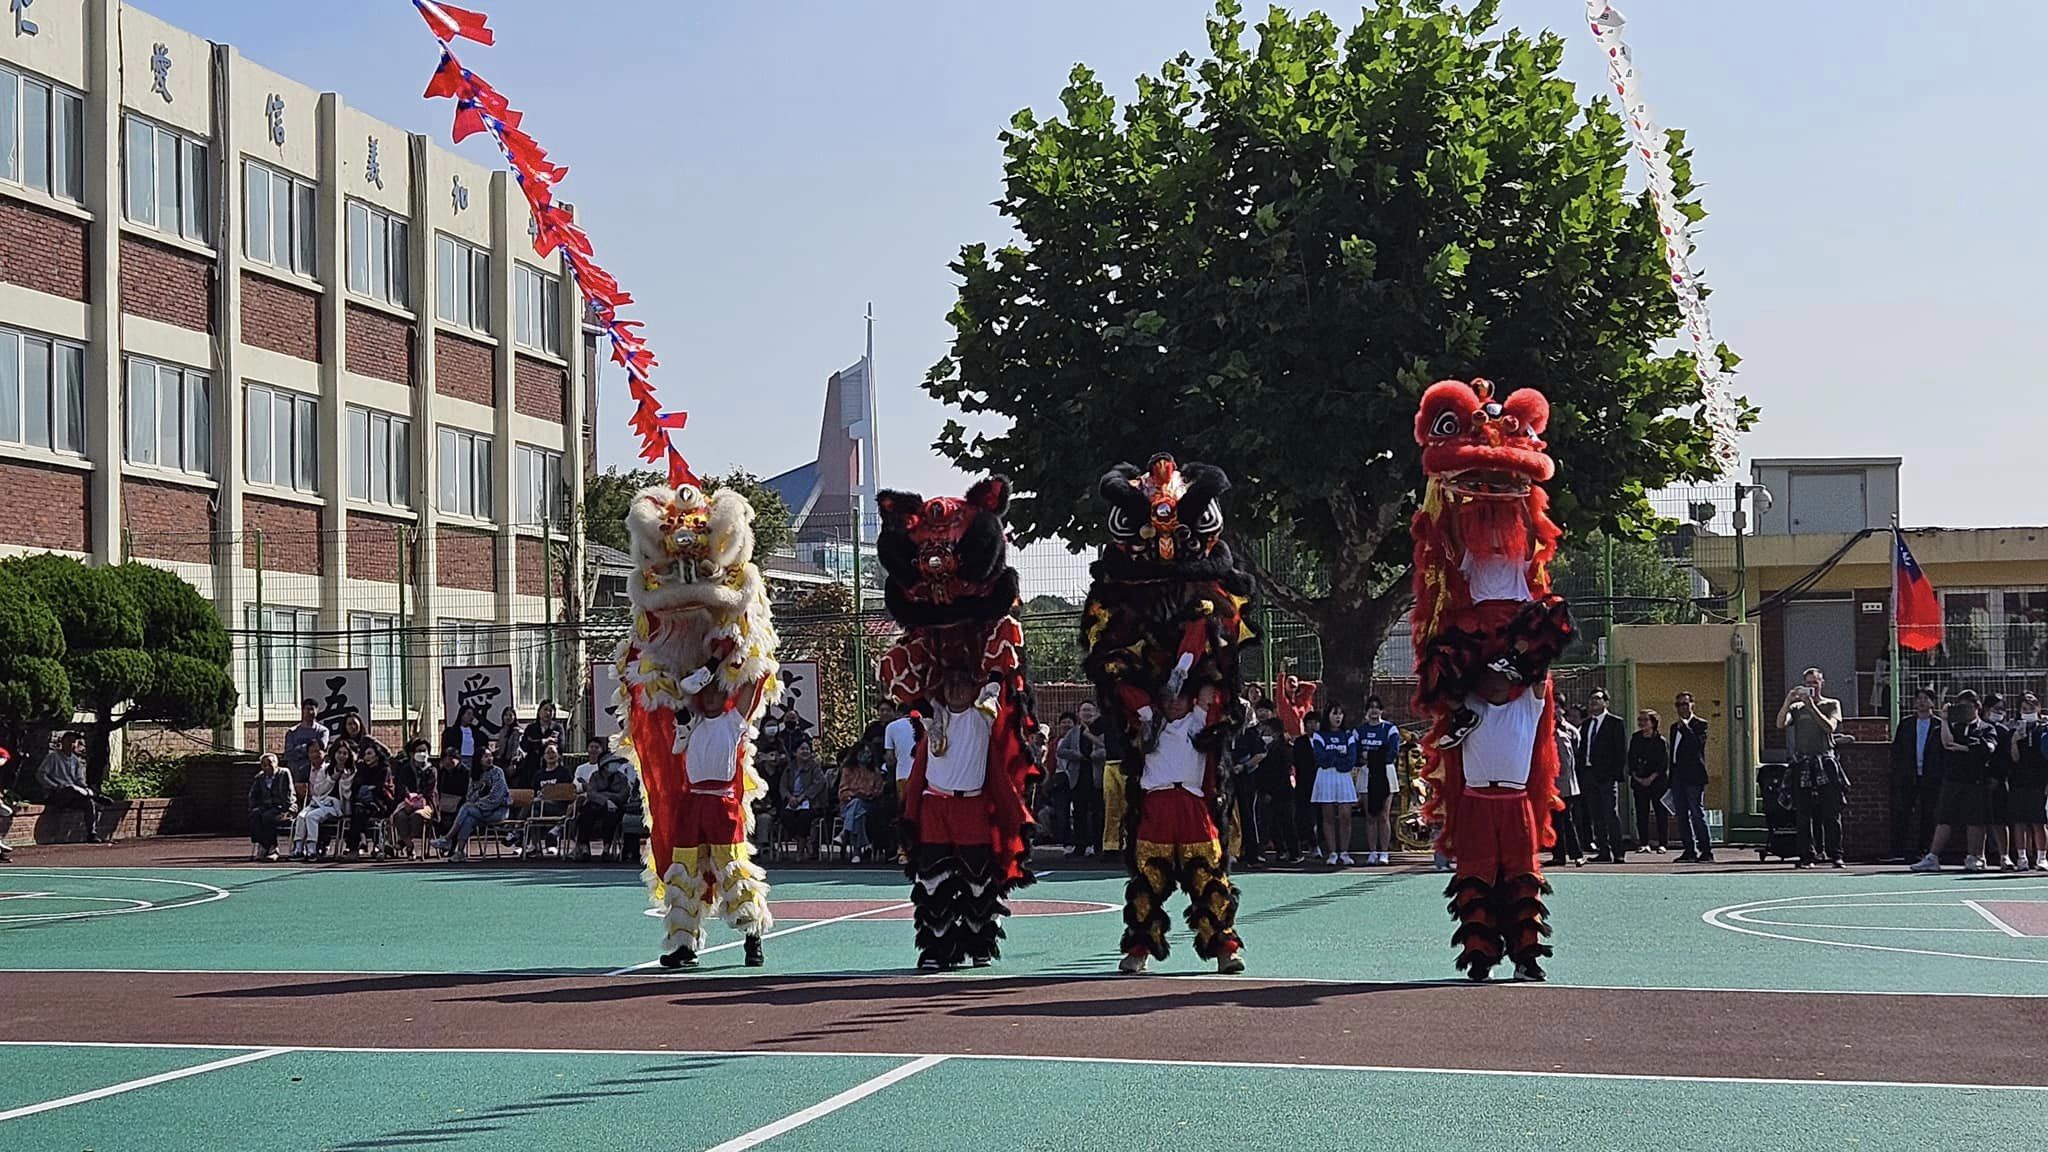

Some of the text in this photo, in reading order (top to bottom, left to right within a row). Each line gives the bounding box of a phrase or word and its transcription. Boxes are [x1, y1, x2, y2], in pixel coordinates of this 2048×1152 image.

[150, 43, 174, 104] 愛
[264, 93, 286, 147] 信
[452, 174, 469, 216] 和
